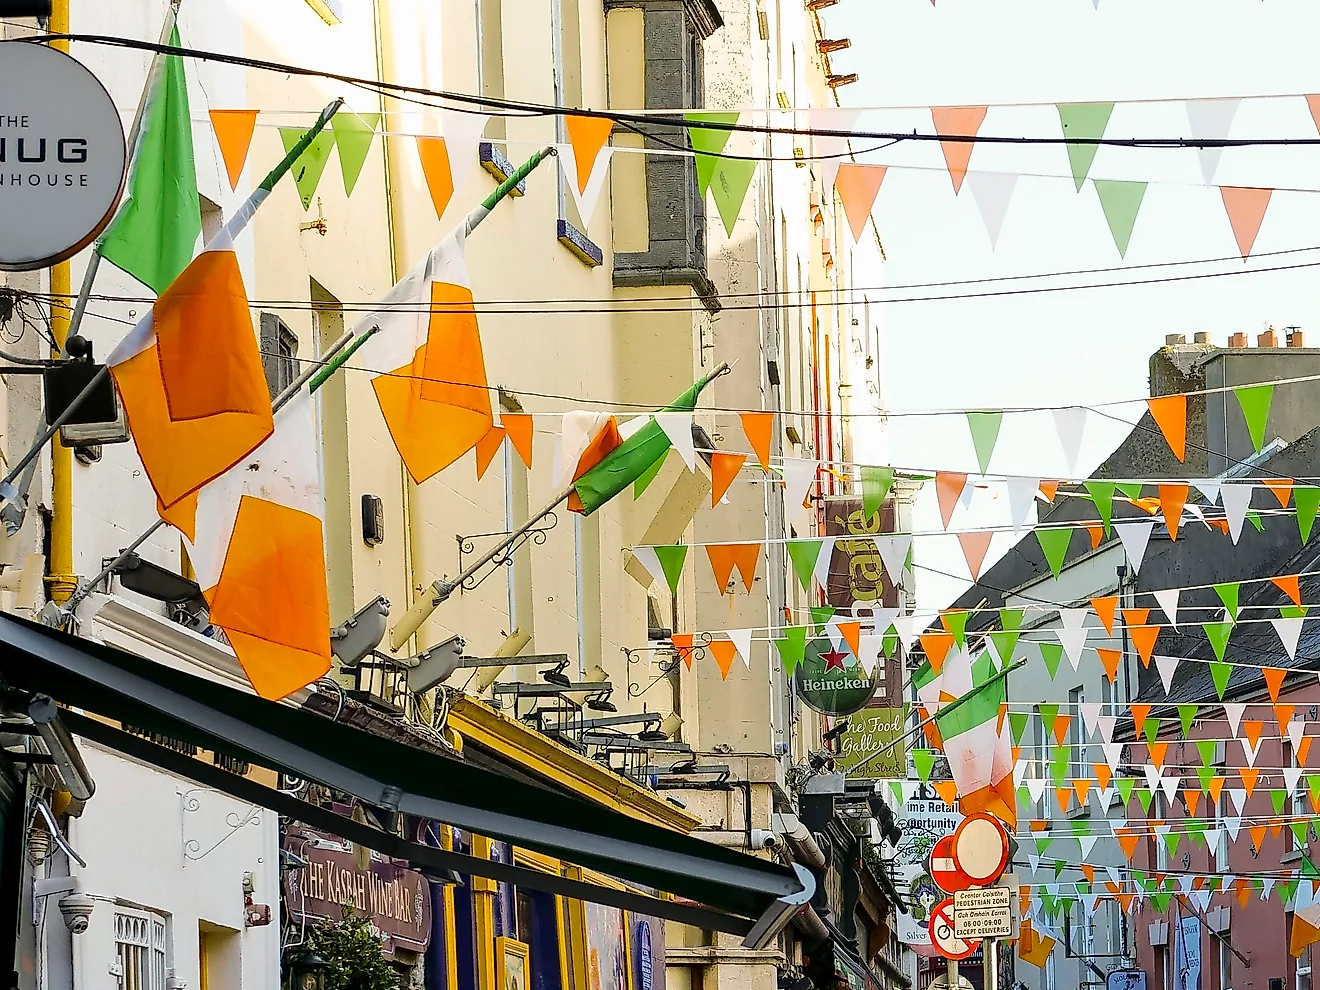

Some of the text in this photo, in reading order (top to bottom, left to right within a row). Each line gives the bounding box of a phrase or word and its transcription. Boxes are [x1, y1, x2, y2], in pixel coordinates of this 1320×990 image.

[803, 677, 871, 692] Heineken
[868, 715, 901, 734] Food
[367, 870, 393, 918] WINE
[393, 879, 412, 924] BAR
[956, 897, 1009, 907] PEDESTRIAN ZONE
[906, 931, 927, 941] Silver
[956, 926, 1009, 936] EXCEPT DELIVERIES
